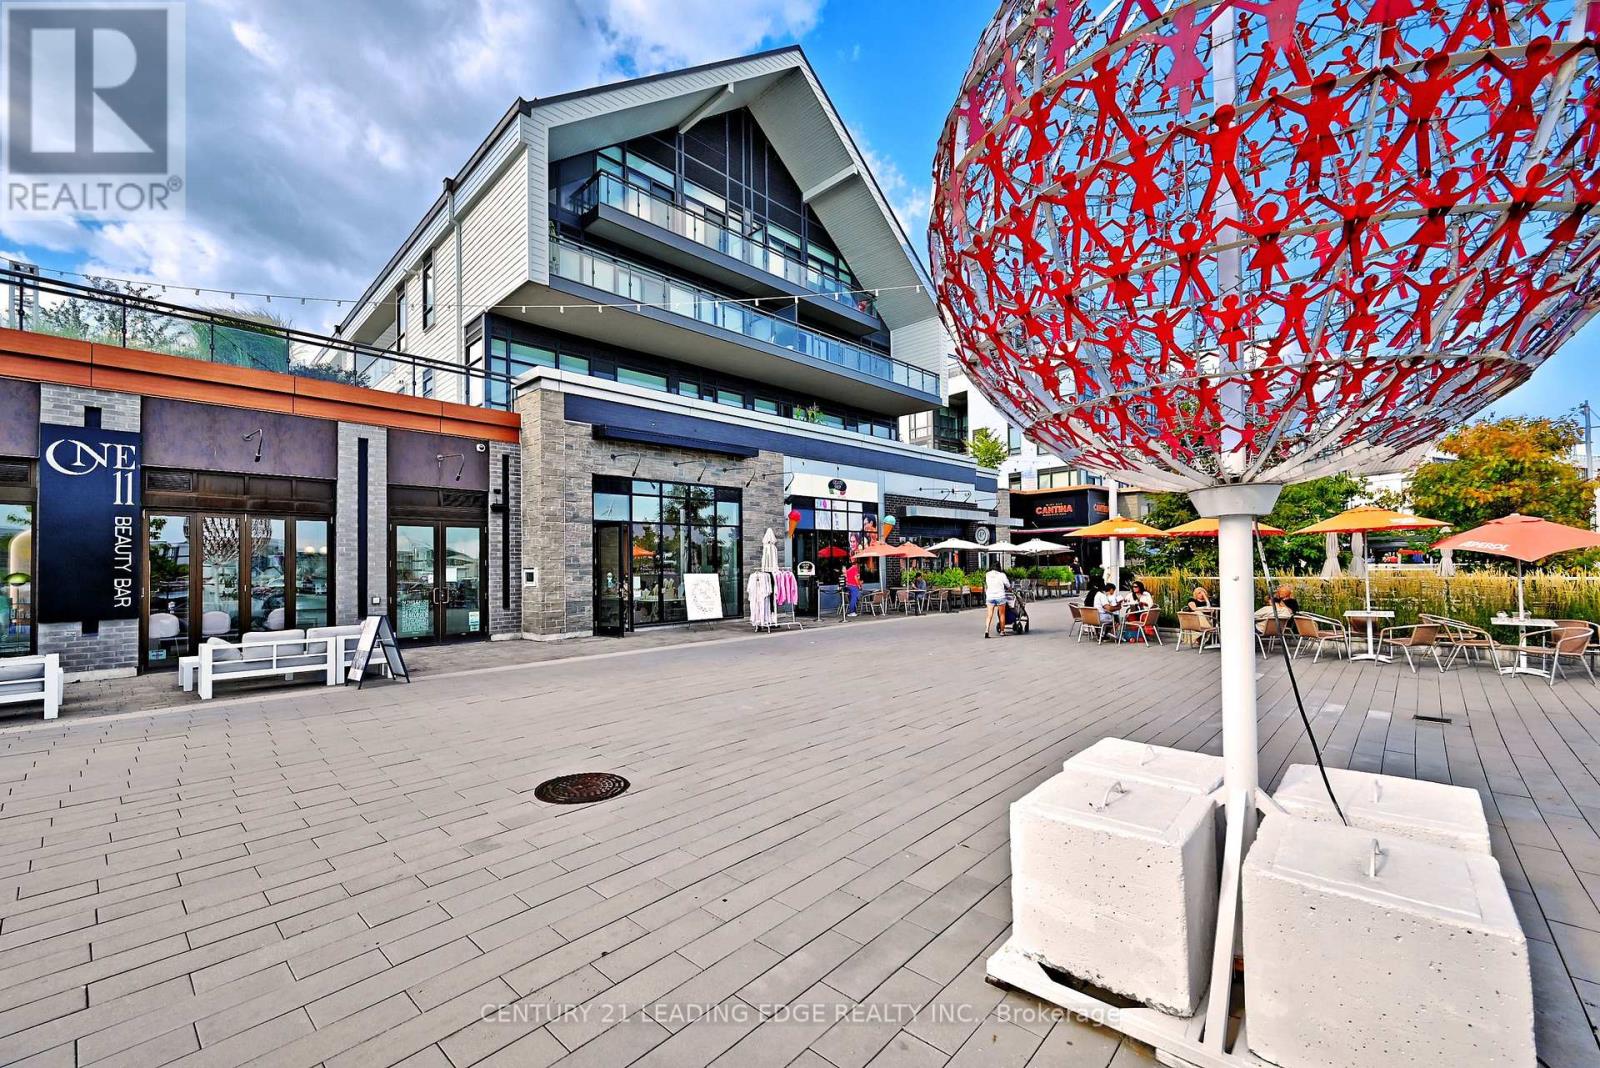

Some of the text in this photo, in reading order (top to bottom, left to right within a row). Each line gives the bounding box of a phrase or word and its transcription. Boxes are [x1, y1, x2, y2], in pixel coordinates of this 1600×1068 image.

[45, 439, 136, 476] ONE
[113, 471, 135, 506] 11
[1035, 504, 1073, 515] CANTINA
[113, 516, 133, 608] BEAUTY BAR
